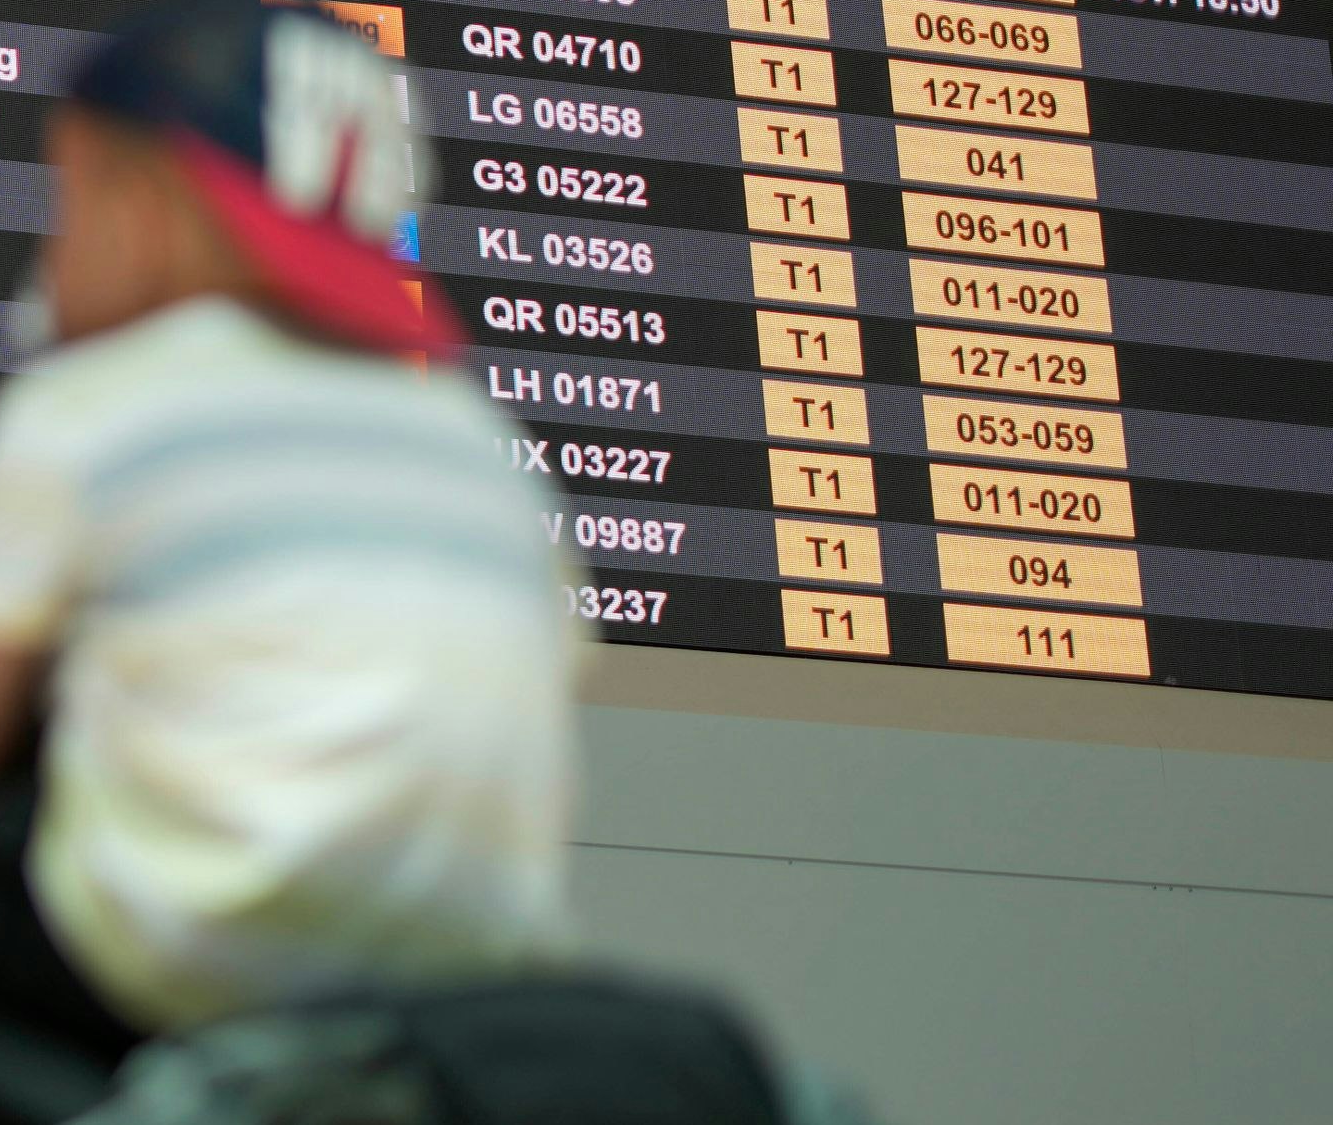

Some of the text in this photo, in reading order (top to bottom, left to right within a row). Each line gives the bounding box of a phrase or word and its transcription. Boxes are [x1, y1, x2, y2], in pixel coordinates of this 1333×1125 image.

[467, 89, 644, 140] LG 06558
[965, 146, 1025, 182] 041
[934, 209, 1070, 252] 096-101
[488, 364, 661, 414] LH 01871
[811, 606, 856, 642] T1
[1017, 624, 1076, 660] 111
